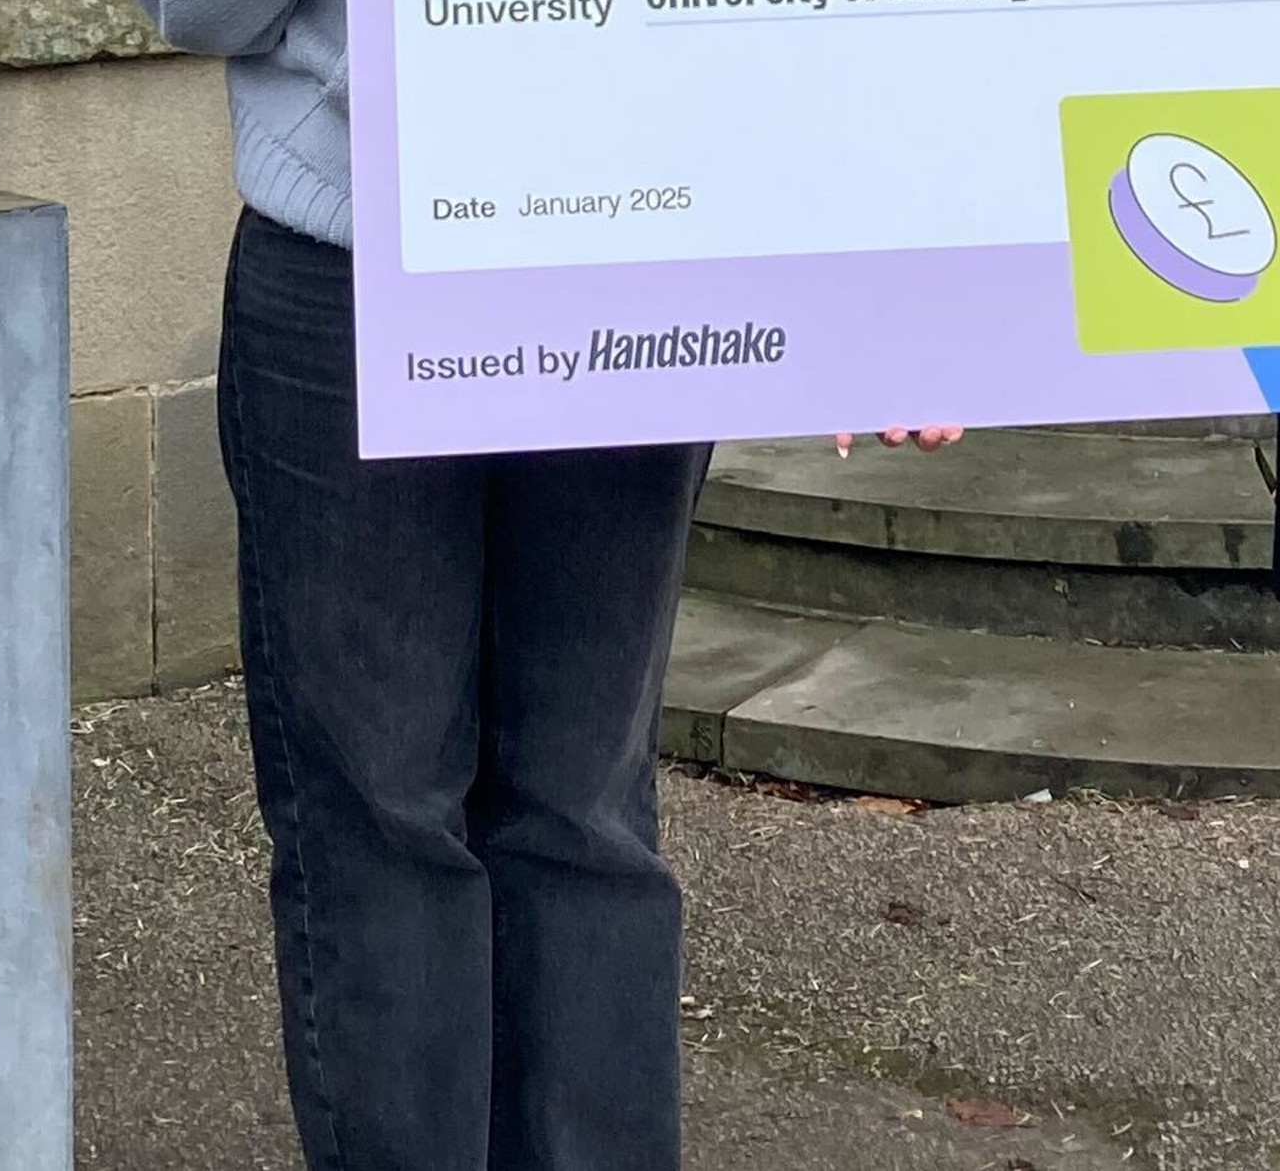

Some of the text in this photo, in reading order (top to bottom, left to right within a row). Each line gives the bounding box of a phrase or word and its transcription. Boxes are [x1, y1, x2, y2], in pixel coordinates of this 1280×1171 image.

[432, 186, 692, 221] Date January 2025
[407, 322, 786, 382] Issued by Handshake
